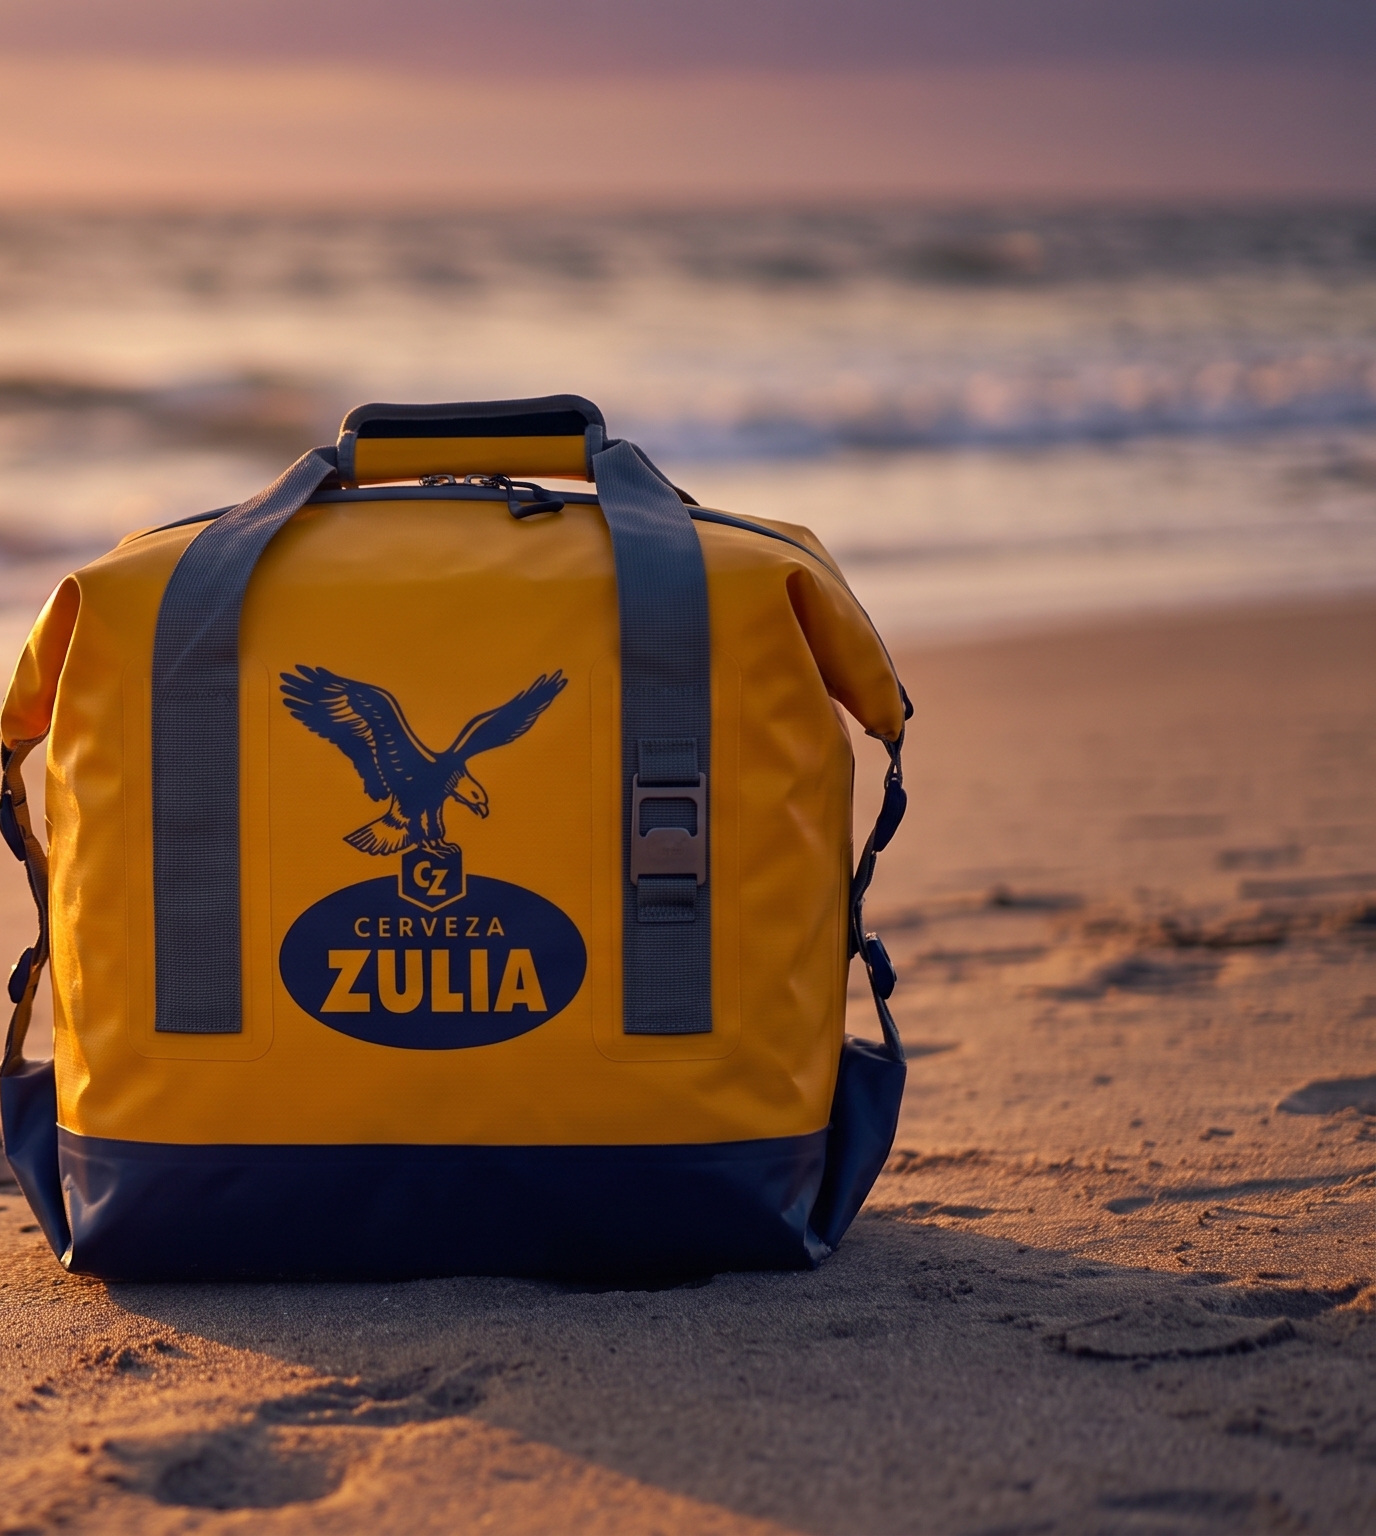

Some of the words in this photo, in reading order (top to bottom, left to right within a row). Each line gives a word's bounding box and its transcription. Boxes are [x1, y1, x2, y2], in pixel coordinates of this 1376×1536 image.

[413, 861, 448, 895] CZ
[354, 917, 505, 937] CERVEZA
[319, 949, 548, 1013] ZULIA
